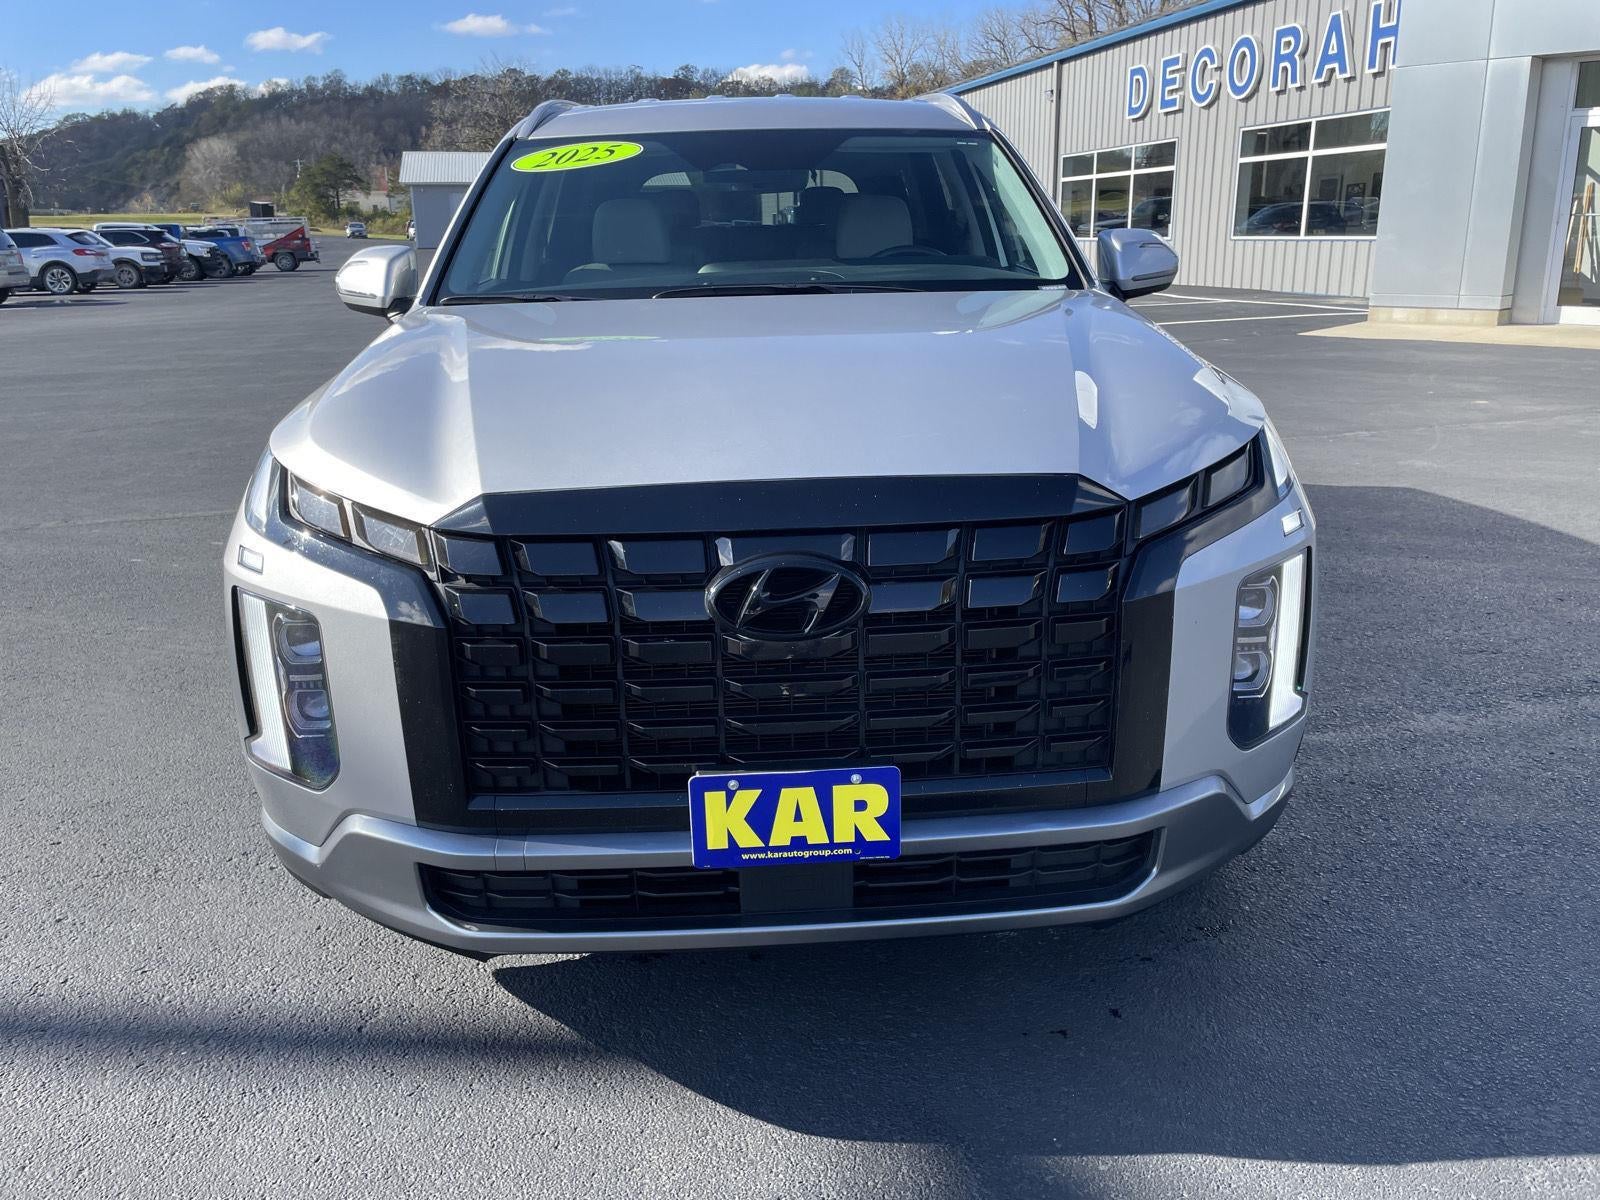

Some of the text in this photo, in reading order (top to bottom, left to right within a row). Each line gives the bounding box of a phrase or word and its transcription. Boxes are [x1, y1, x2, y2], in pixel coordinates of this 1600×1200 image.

[1126, 0, 1401, 120] DECORAH
[531, 144, 622, 168] 2025
[704, 783, 891, 850] KAR
[741, 848, 853, 860] www.karautogroup.com
